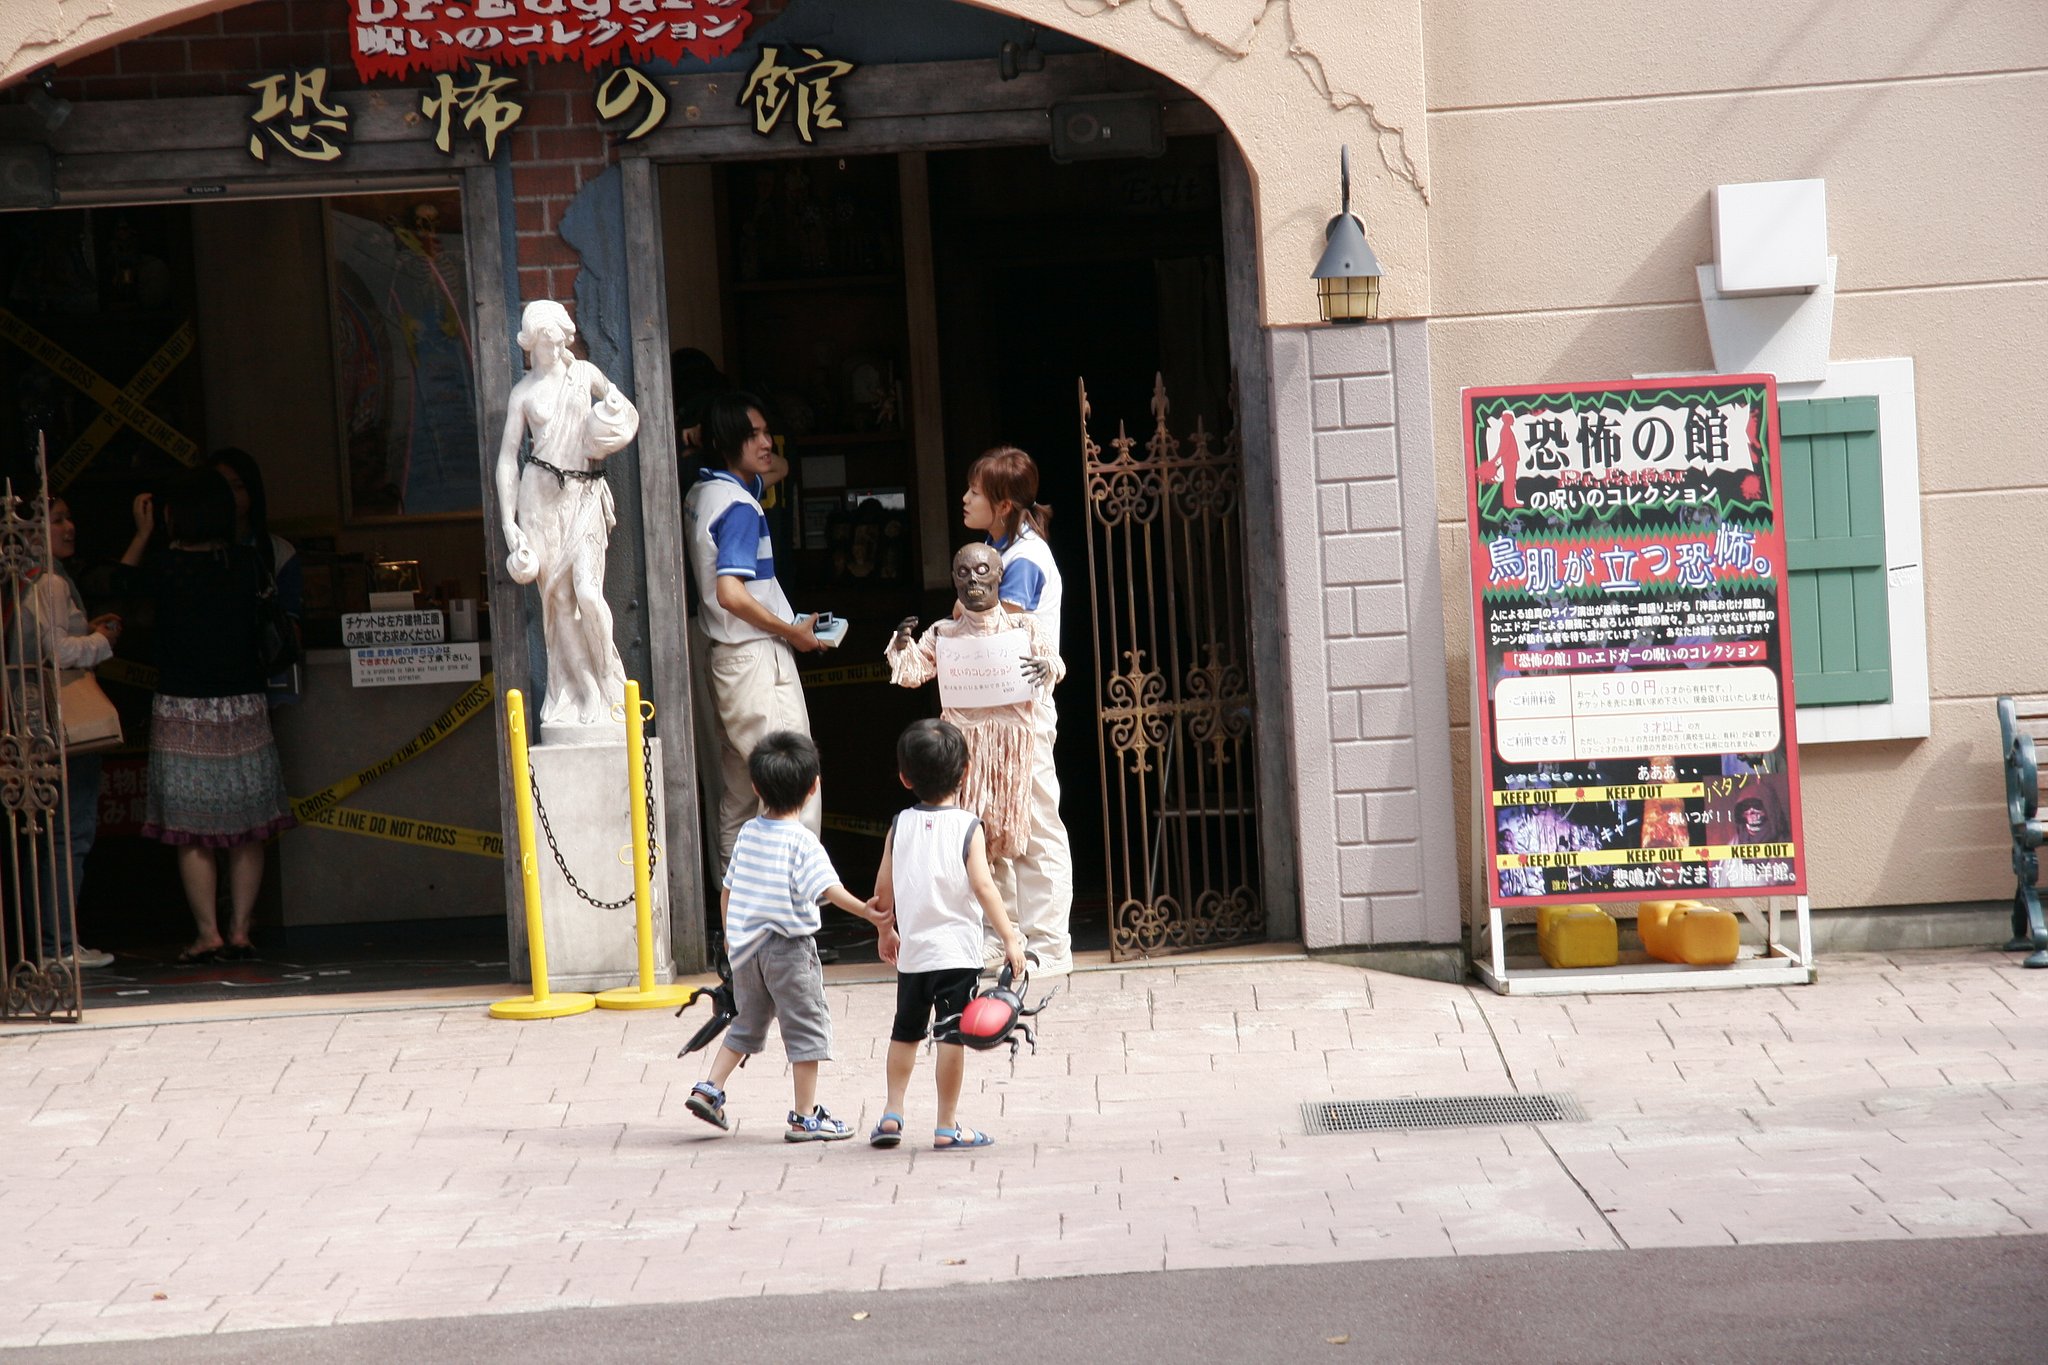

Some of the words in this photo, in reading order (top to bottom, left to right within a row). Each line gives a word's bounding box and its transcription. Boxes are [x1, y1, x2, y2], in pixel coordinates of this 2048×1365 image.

[356, 14, 742, 56] 呪いのコレクション
[248, 46, 856, 162] 恐怖の館
[60, 355, 96, 390] CROSS
[133, 367, 158, 396] LINE
[111, 395, 150, 430] POLICE
[148, 421, 174, 446] LINE
[64, 438, 94, 473] CROSS
[1524, 410, 1731, 472] 恐怖の館
[1530, 483, 1718, 511] の呪いのコレクション
[1488, 522, 1772, 593] 鳥肌が立つ恐怖。
[346, 612, 440, 629] チケットは左方建物正面
[346, 628, 441, 644] の売場でお求めください
[1602, 680, 1657, 697] 500円
[358, 755, 395, 786] POLICE
[397, 737, 421, 763] LINE
[420, 727, 437, 746] DO
[434, 711, 457, 736] NOT
[456, 683, 491, 718] CROSS
[299, 788, 337, 819] CROSS
[1501, 791, 1532, 806] KEEP
[1534, 789, 1558, 804] OUT
[1605, 787, 1637, 801] KEEP
[1639, 785, 1663, 799] OUT
[338, 810, 367, 831] LINE
[369, 816, 387, 834] DO
[389, 820, 415, 839] NOT
[416, 826, 458, 846] CROSS
[1600, 818, 1639, 844] キャー
[1553, 853, 1578, 867] OUT
[1626, 849, 1657, 863] KEEP
[1659, 848, 1684, 862] OUT
[1731, 845, 1762, 859] KEEP
[1764, 843, 1789, 857] OUT
